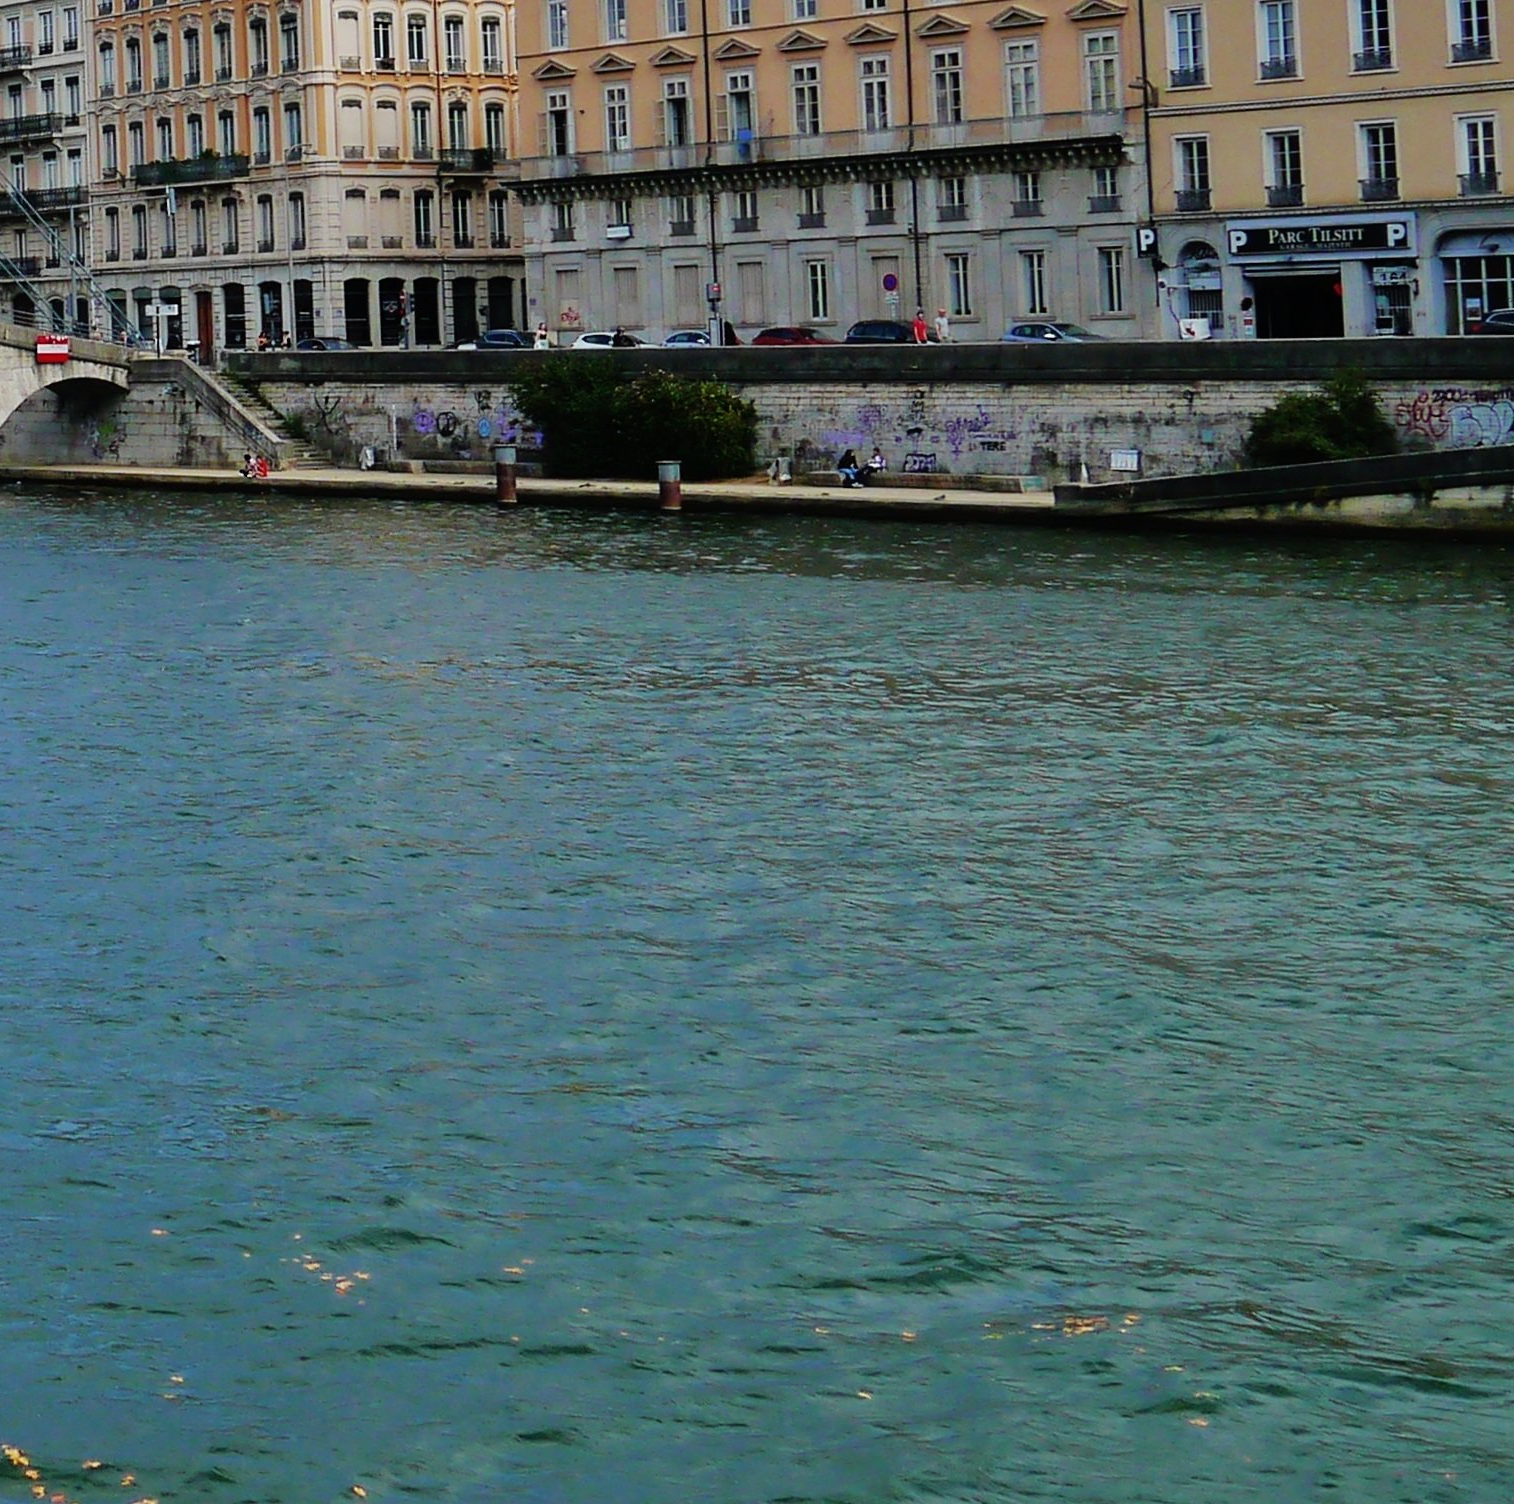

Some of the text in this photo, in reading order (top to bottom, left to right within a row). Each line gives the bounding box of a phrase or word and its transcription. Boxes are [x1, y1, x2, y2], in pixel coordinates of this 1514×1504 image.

[1139, 228, 1155, 251] P
[1230, 230, 1248, 253] P
[1268, 227, 1364, 244] PARC TILSITT
[1386, 223, 1406, 246] P
